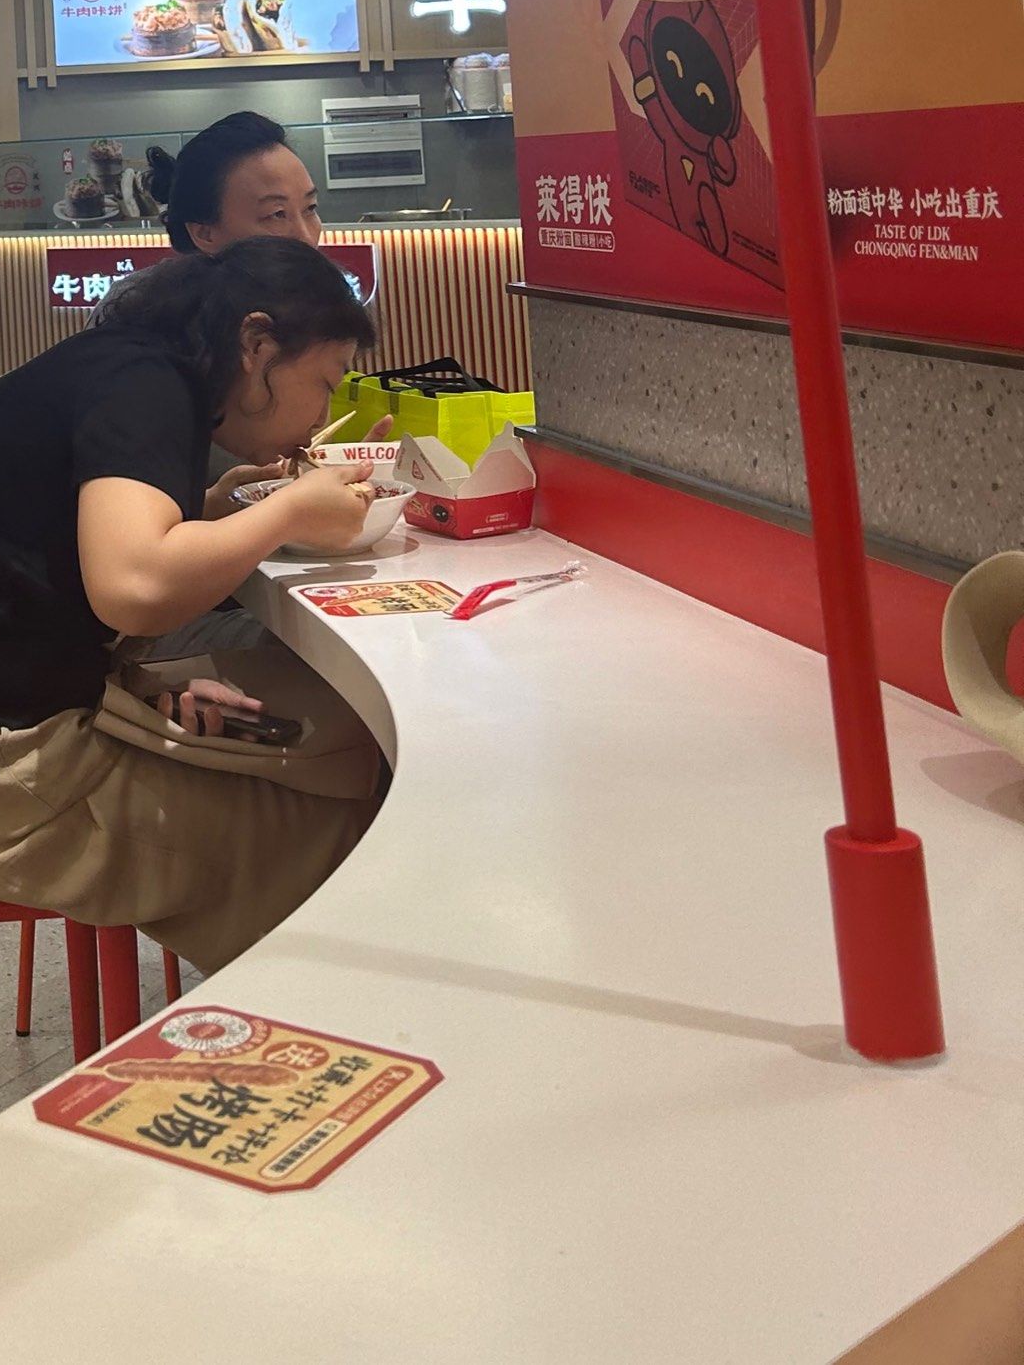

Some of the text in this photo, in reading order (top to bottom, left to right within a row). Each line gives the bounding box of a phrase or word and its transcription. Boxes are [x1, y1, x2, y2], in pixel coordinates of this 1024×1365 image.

[535, 174, 613, 226] 莱得快
[827, 187, 1002, 219] 粉面道中华 小吃出重庆
[875, 225, 950, 242] TASTE OF LDK
[855, 241, 978, 261] CHONGQING FEN&MIAN
[52, 273, 131, 303] 牛肉
[343, 447, 400, 460] WELCO
[136, 1078, 272, 1149] 烤肠
